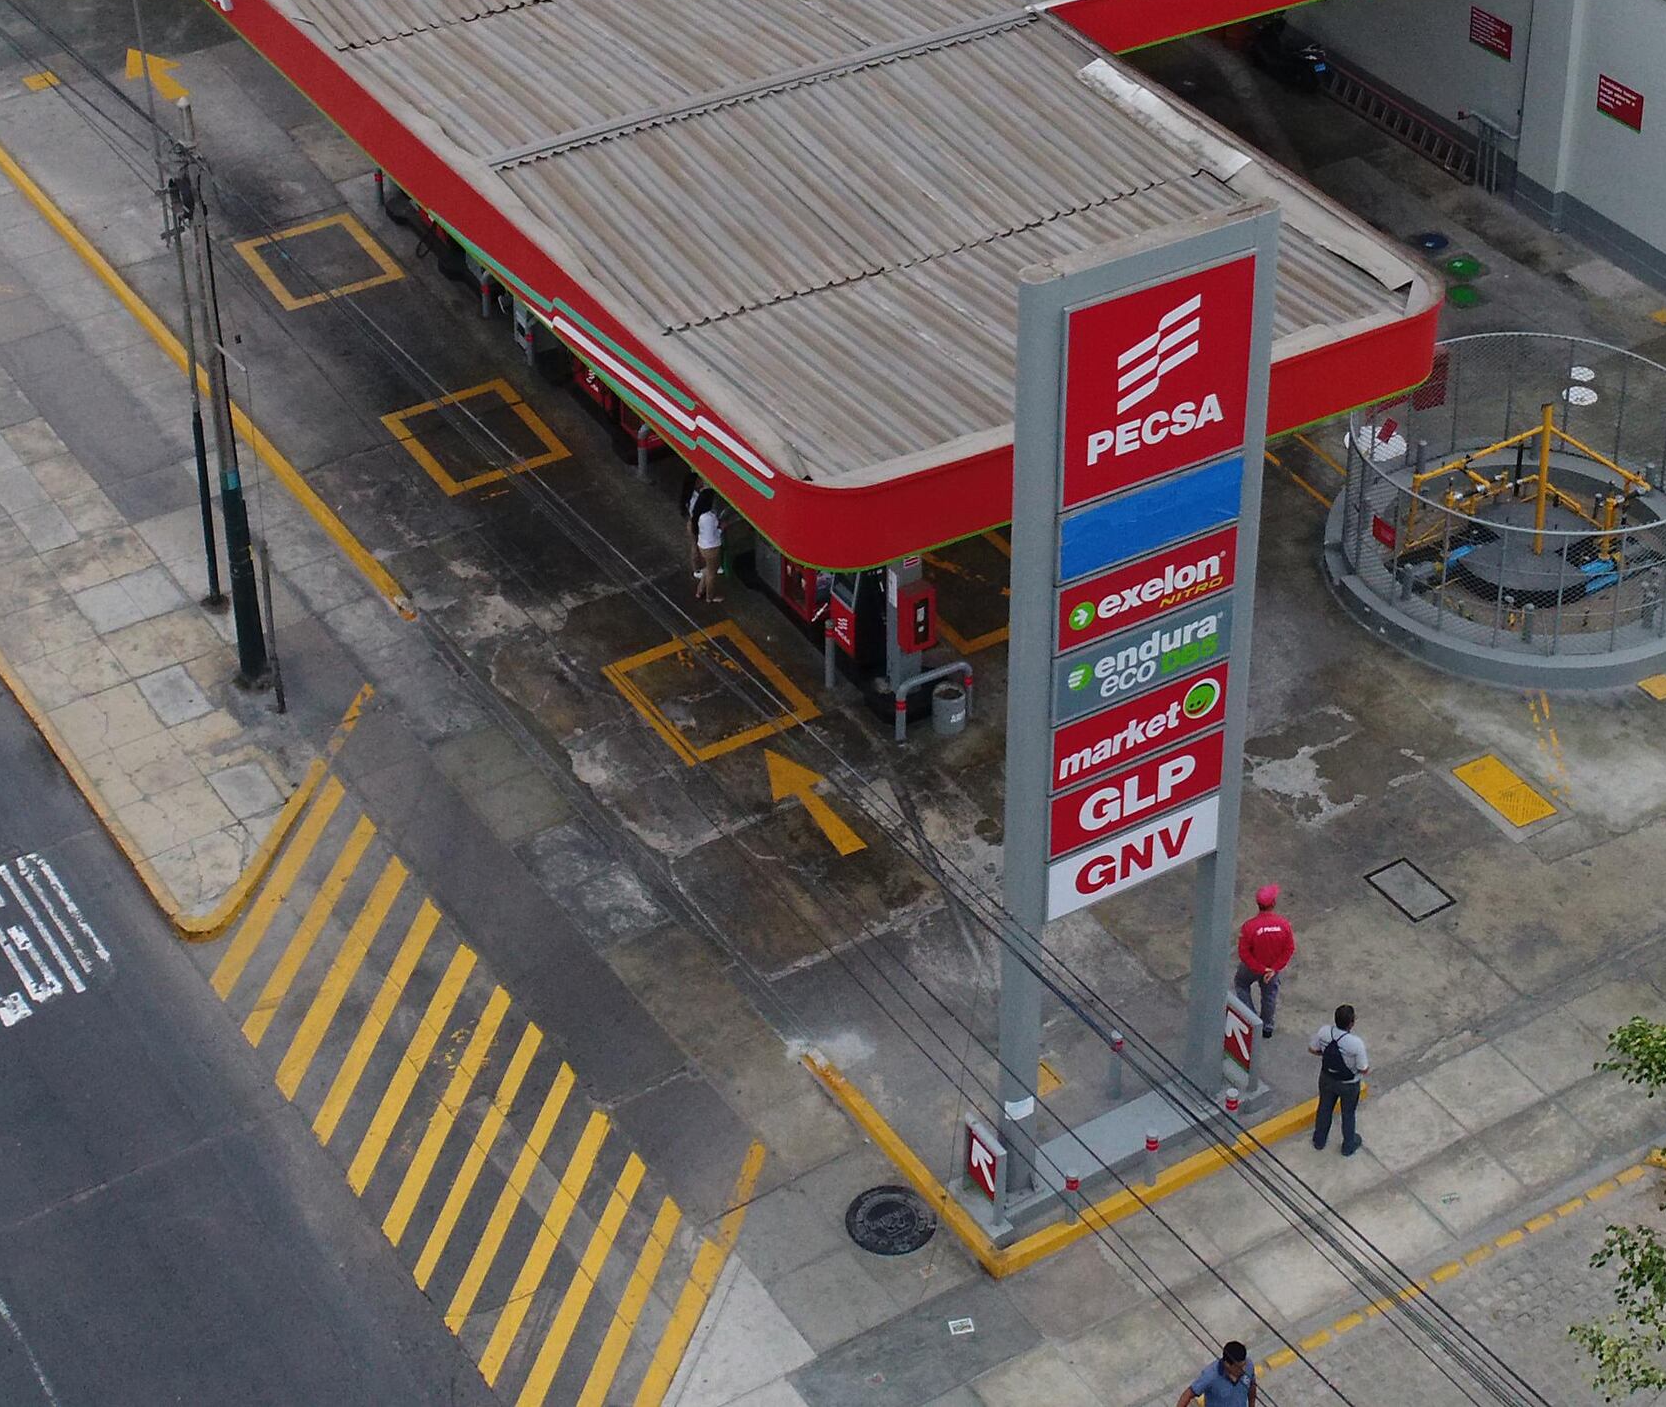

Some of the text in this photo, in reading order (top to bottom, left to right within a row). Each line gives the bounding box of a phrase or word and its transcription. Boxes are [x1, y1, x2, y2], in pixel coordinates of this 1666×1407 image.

[1087, 393, 1224, 466] PECSA
[1097, 555, 1220, 619] exelon
[1159, 575, 1224, 608] NITRO
[1094, 614, 1217, 678] endura
[1100, 660, 1156, 697] eco
[1058, 701, 1181, 781] market
[1078, 755, 1196, 831] GLP
[1075, 816, 1194, 895] GNV
